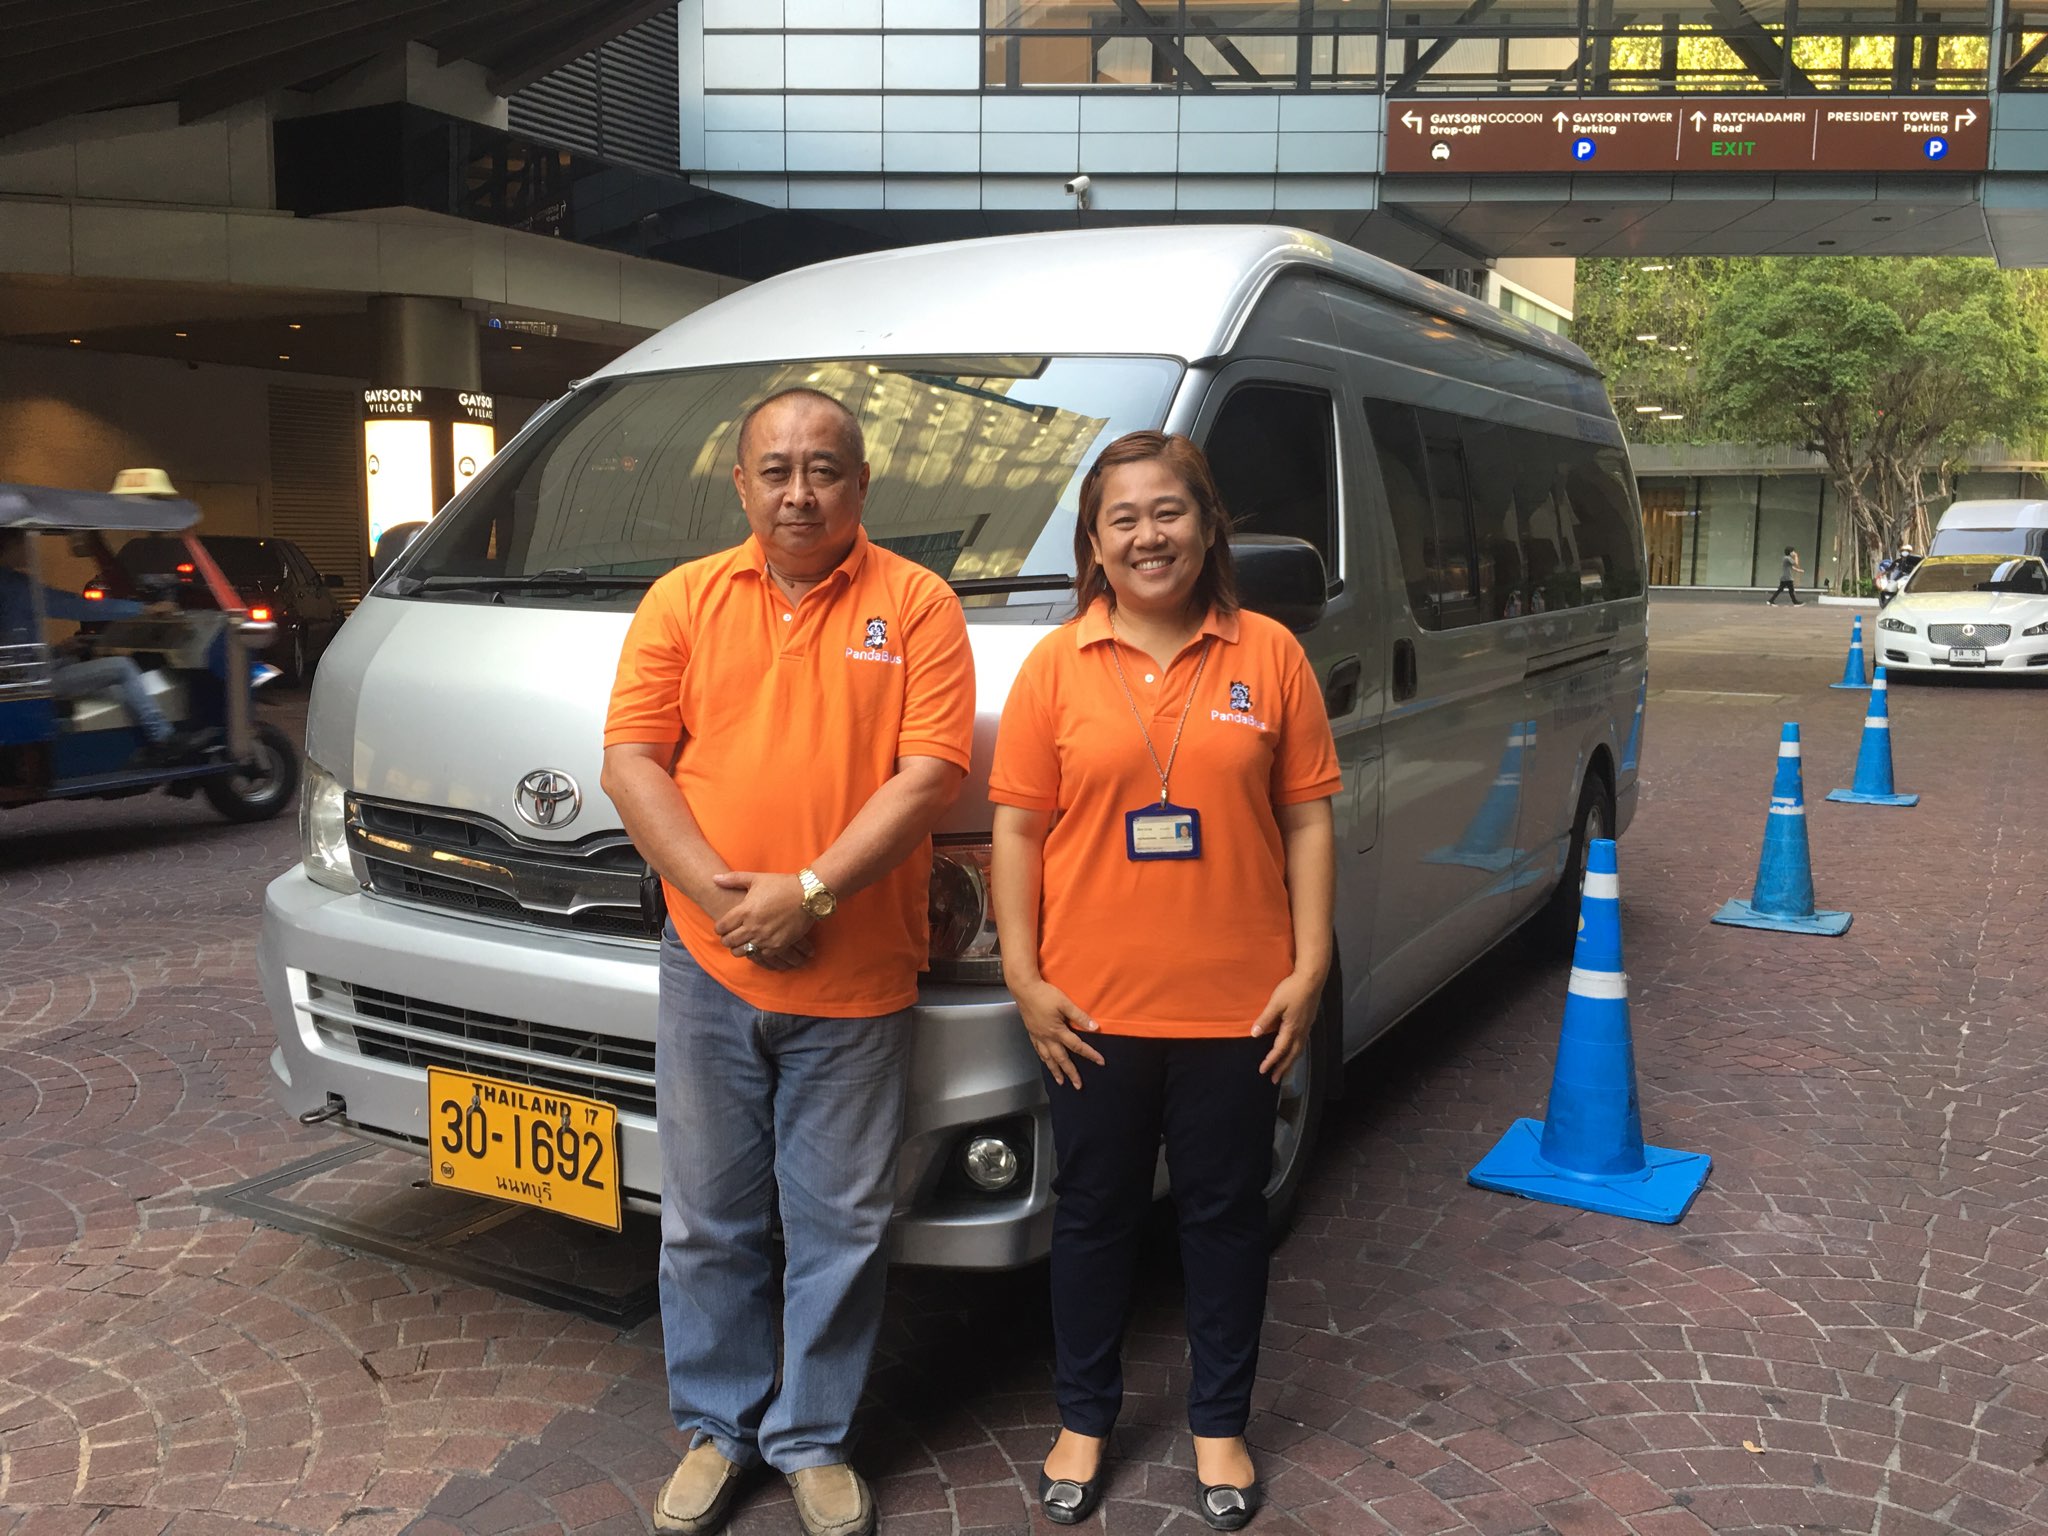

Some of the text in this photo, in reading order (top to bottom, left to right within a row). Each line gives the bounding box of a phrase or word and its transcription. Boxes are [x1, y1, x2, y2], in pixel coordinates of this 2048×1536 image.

[1572, 112, 1673, 123] GAYSORN TOWER
[1713, 112, 1806, 123] RATCHADAMRI
[1827, 111, 1950, 122] PRESIDENT TOWER
[1430, 125, 1481, 136] Drop-Off
[1572, 124, 1617, 135] Parking
[1713, 123, 1743, 133] Road
[1903, 123, 1948, 134] Parking
[1711, 141, 1757, 156] EXIT
[364, 389, 422, 403] GAYSORN
[369, 403, 413, 413] VILLAGE
[845, 647, 902, 664] PandaBus
[472, 1083, 599, 1126] THAILAND 17
[441, 1100, 604, 1190] 30-1692
[496, 1176, 552, 1203] นนทบุรี
